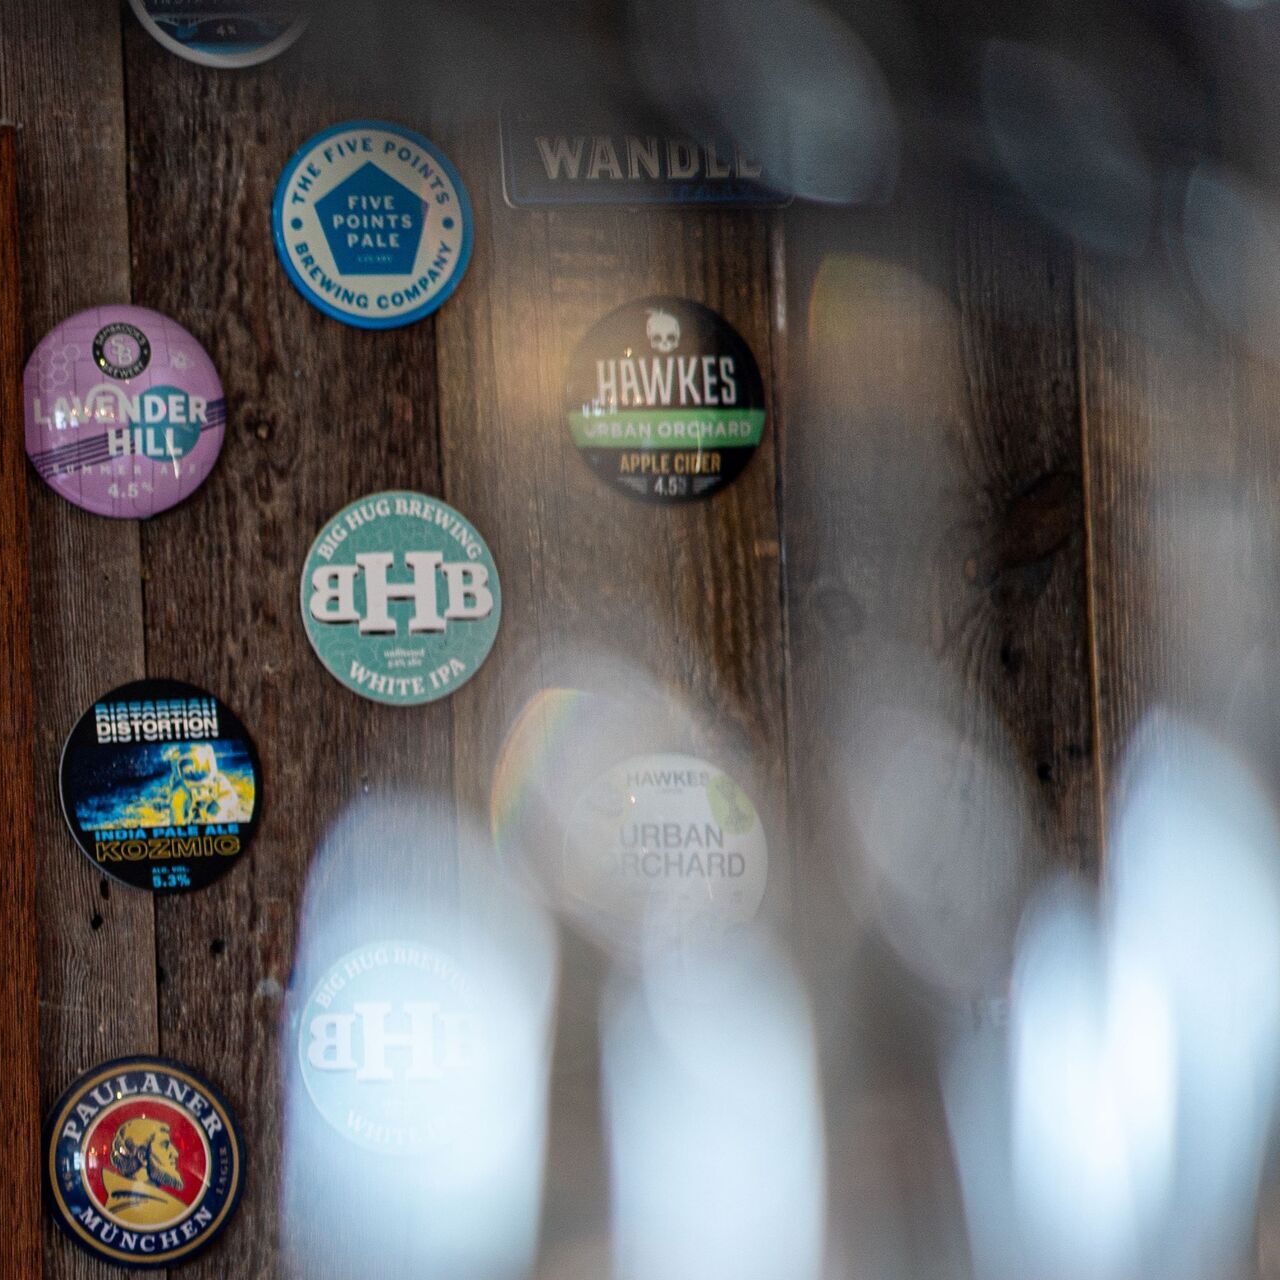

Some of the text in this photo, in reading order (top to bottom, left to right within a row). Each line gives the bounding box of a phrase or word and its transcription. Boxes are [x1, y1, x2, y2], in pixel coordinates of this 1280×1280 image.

[348, 196, 395, 210] FIVE
[333, 214, 412, 229] POINTS
[347, 234, 400, 248] PALE
[596, 356, 736, 406] HAWKES
[33, 394, 209, 424] LAVENDER
[108, 428, 183, 456] HILL
[620, 452, 721, 474] APPLE CIDER
[317, 497, 482, 561] BIG HUG BREWING
[349, 657, 466, 696] WHITE IPA
[95, 710, 219, 743] DISTORTION
[95, 823, 239, 841] INDIA PALE ALE
[95, 835, 240, 862] KOZMIO
[63, 1072, 223, 1143] PAULANER
[79, 1206, 212, 1252] MÜNCHEN
